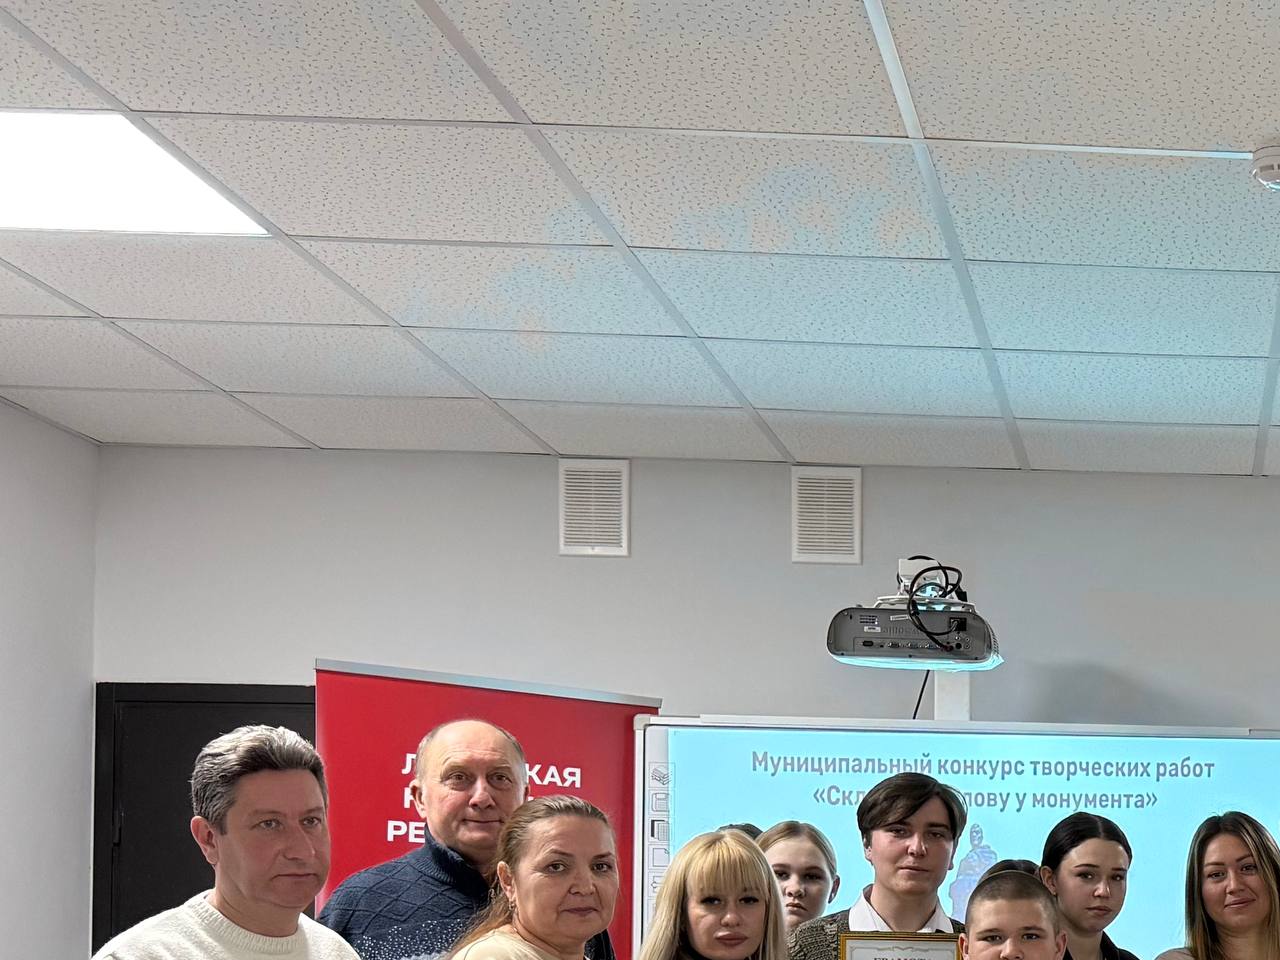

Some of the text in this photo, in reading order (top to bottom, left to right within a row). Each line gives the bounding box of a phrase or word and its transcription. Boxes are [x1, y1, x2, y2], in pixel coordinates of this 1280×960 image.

[752, 751, 1215, 782] Муниципальный конкурс творческих работ
[1015, 792, 1027, 813] у
[1032, 791, 1158, 812] монумента»
